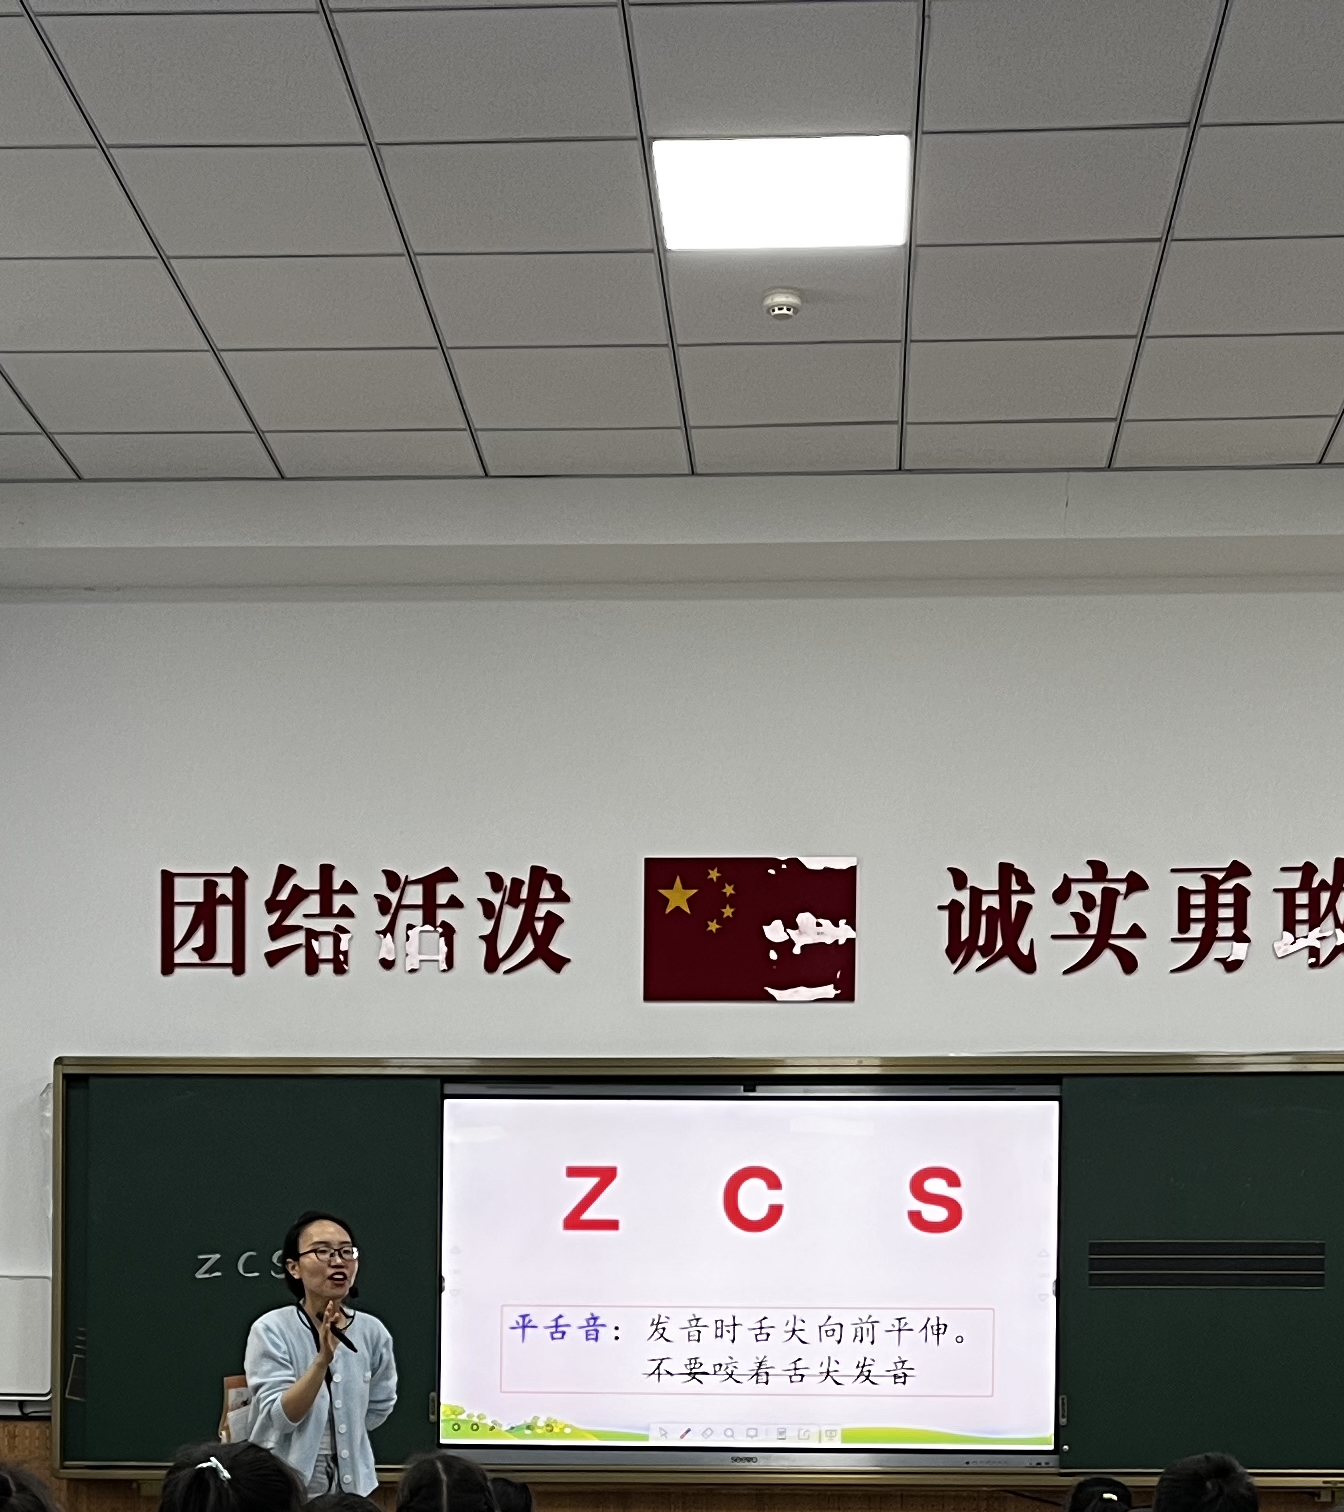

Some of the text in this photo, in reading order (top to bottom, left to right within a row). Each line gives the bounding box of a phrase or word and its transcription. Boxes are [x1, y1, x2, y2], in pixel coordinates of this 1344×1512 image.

[159, 862, 573, 977] 团结活泼
[646, 1355, 916, 1387] 不要咬着舌尖发音
